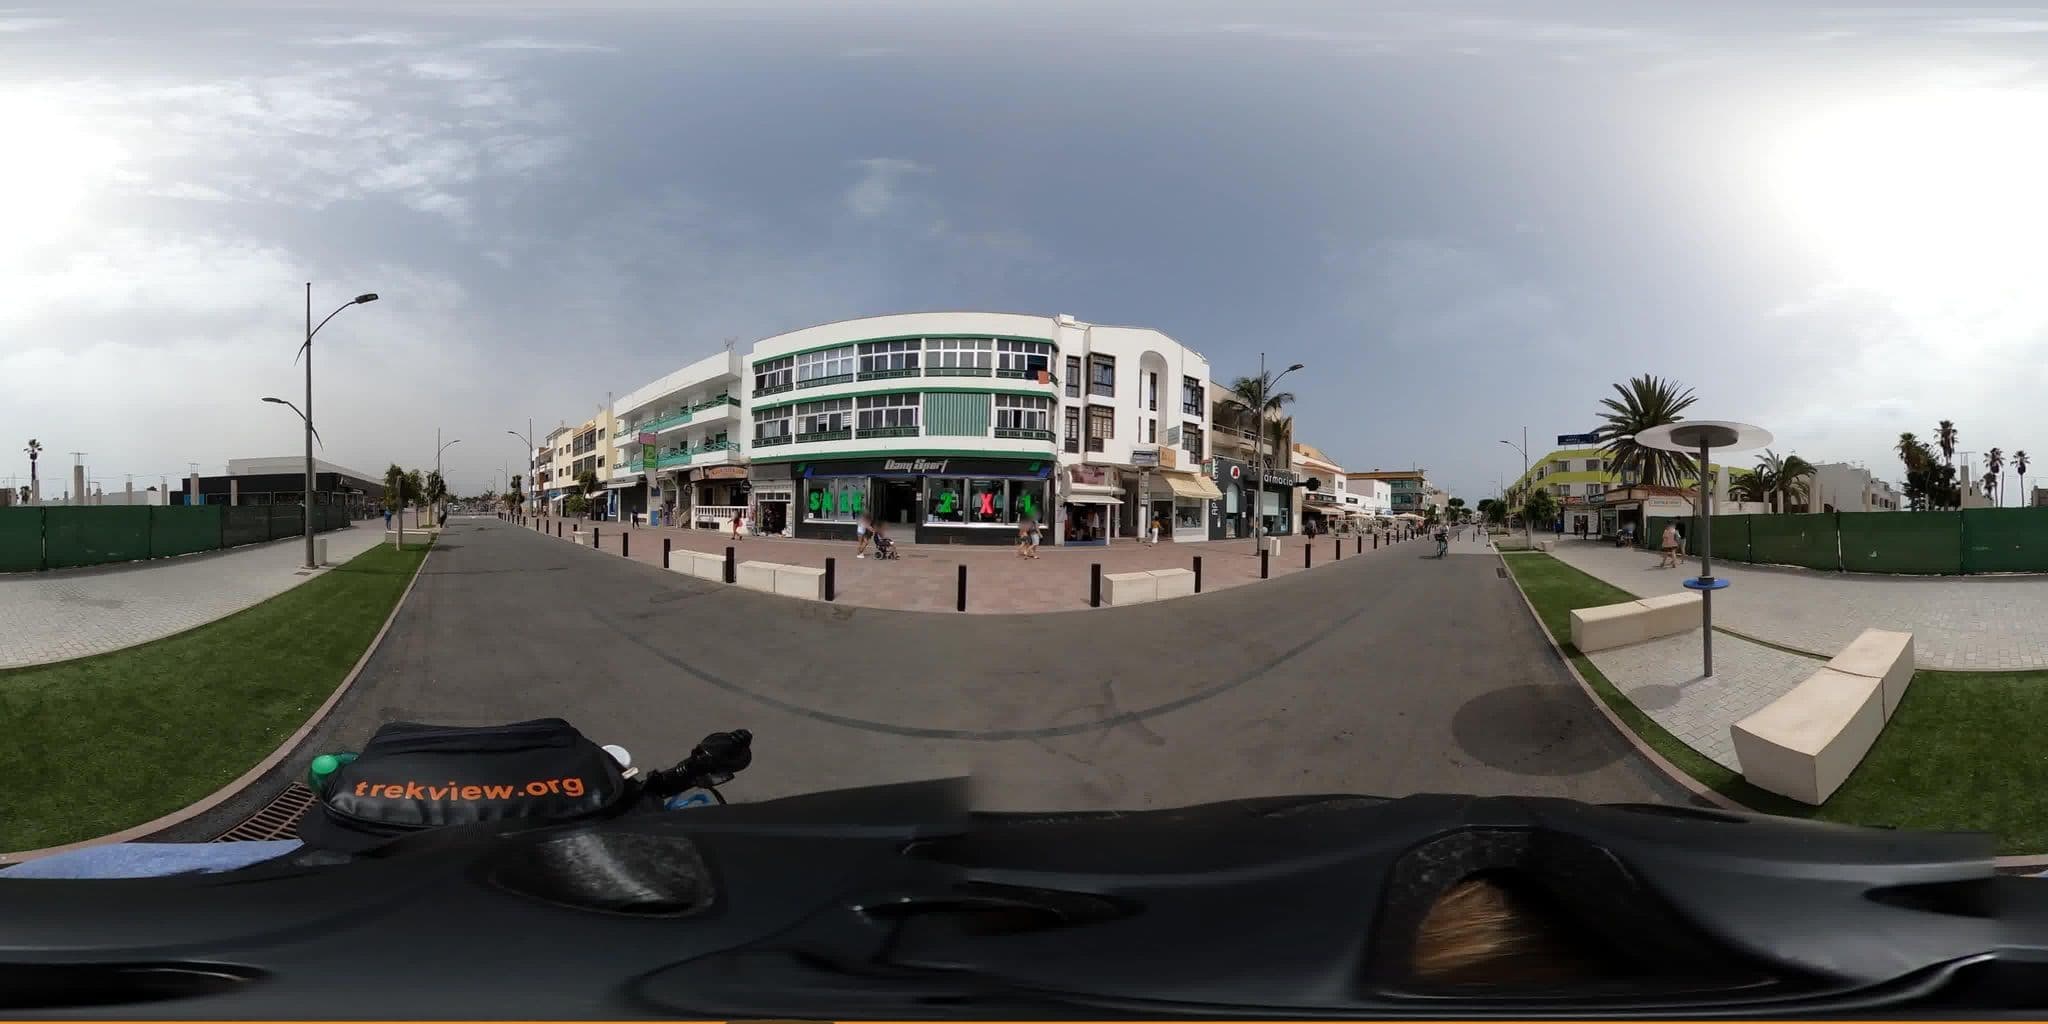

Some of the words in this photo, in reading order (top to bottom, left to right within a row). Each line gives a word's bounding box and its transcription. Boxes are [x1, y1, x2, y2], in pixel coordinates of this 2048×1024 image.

[913, 458, 949, 474] Sport
[1261, 472, 1294, 487] armacia
[354, 777, 585, 801] trekview.org
